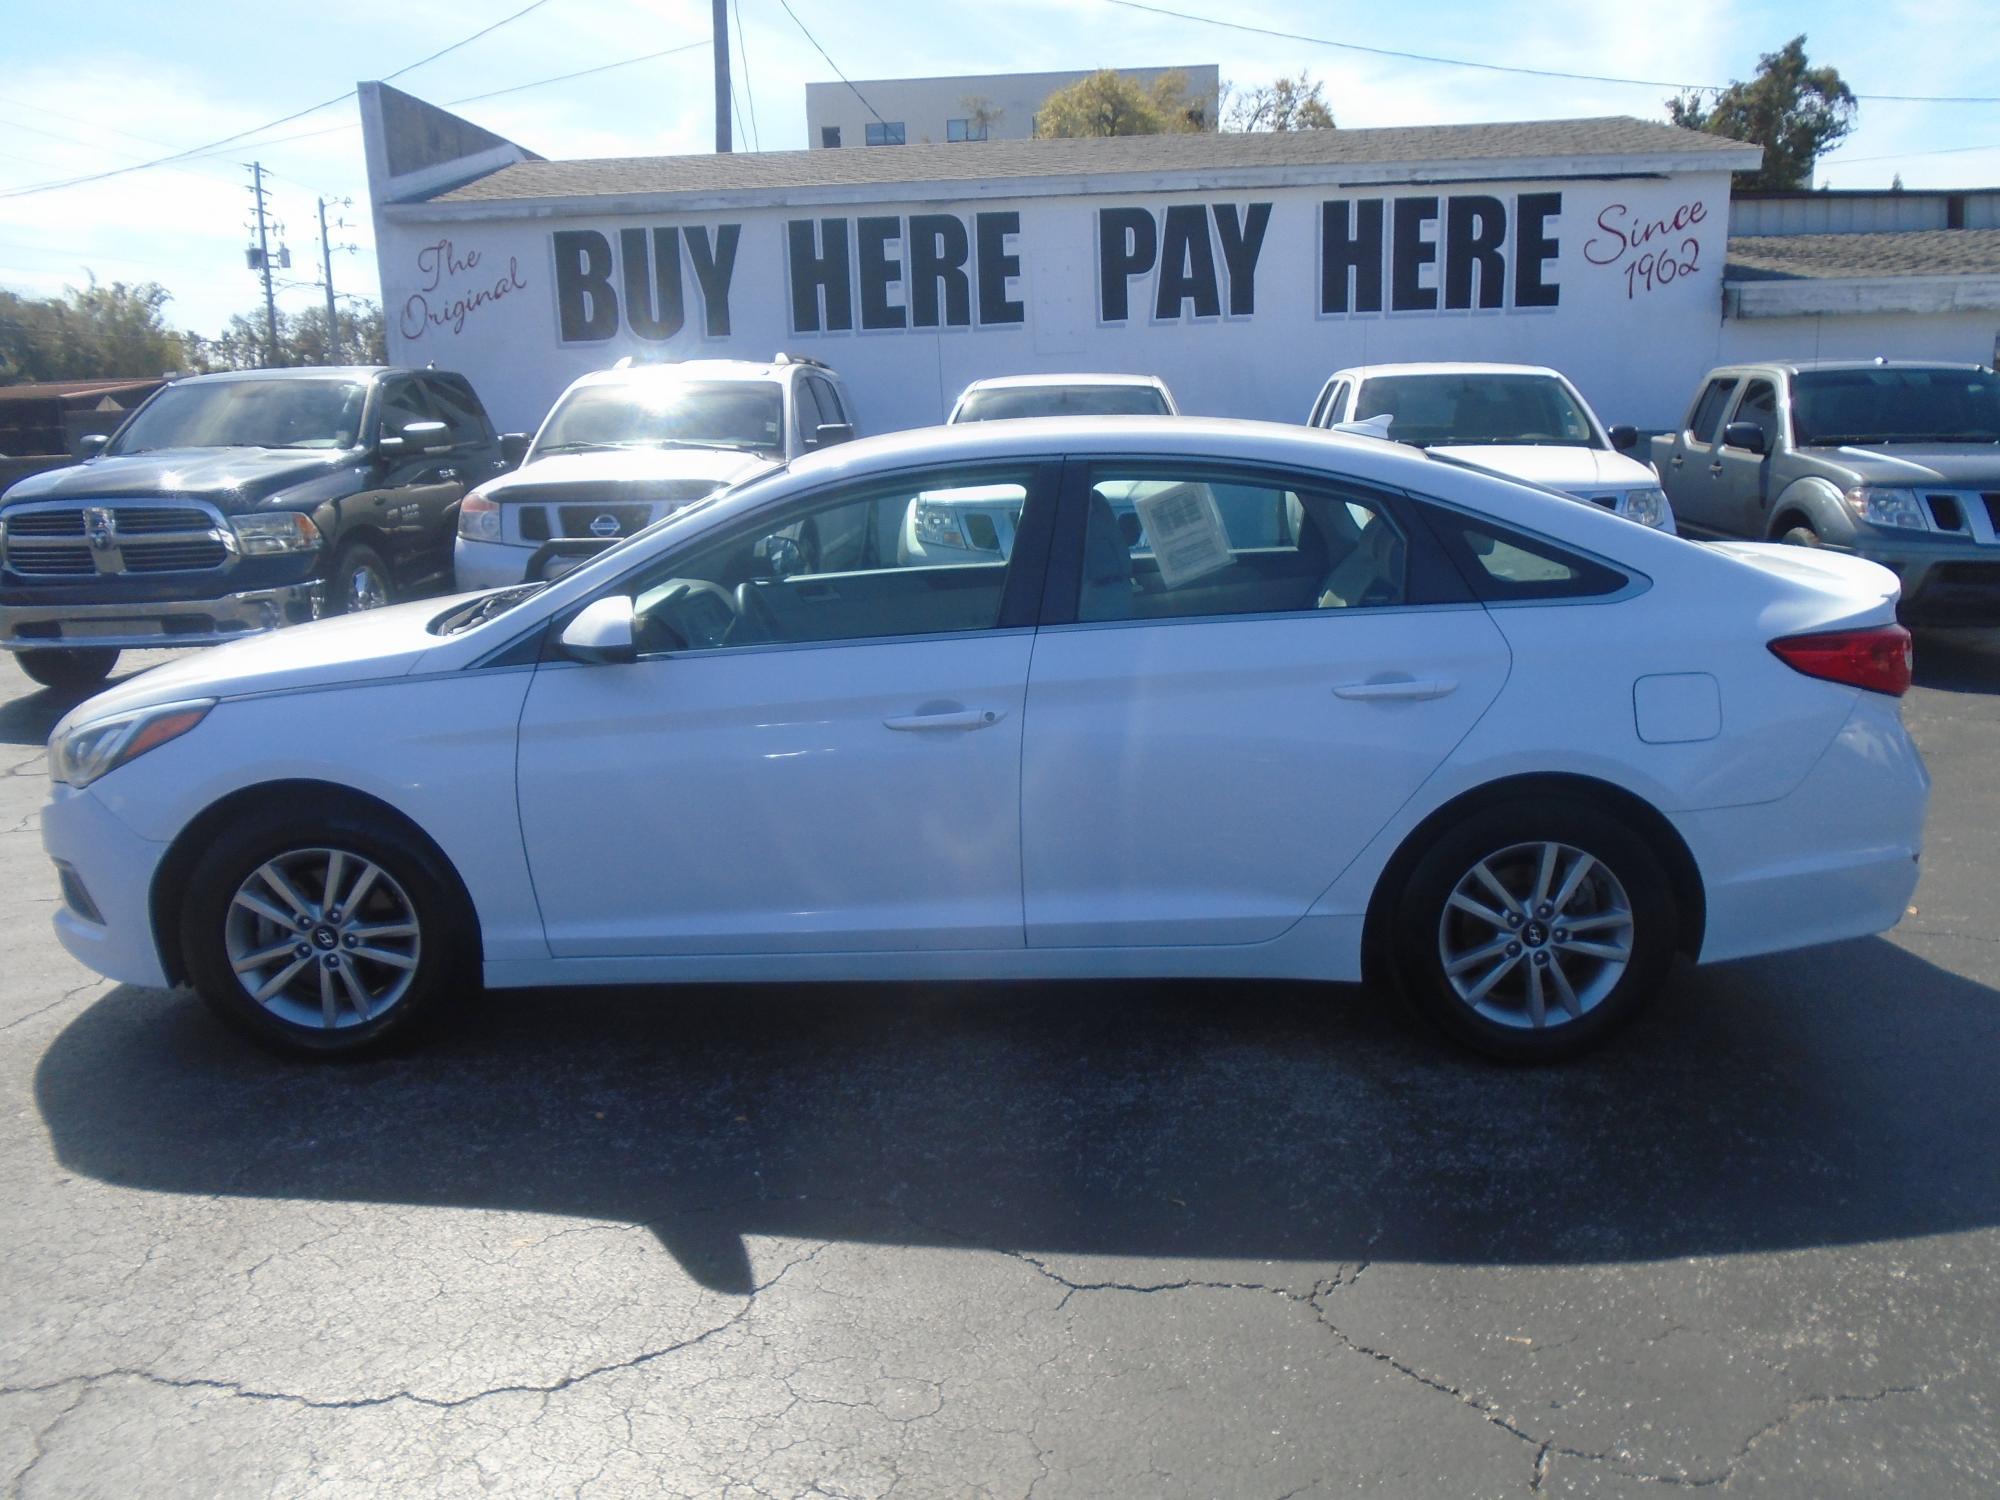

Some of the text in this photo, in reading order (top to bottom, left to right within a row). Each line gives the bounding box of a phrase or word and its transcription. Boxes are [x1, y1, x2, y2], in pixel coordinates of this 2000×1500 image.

[417, 238, 482, 292] The
[1583, 200, 1708, 265] Since
[399, 255, 527, 340] Original
[551, 191, 1563, 343] BUY HERE PAY HERE
[1624, 237, 1700, 300] 1962
